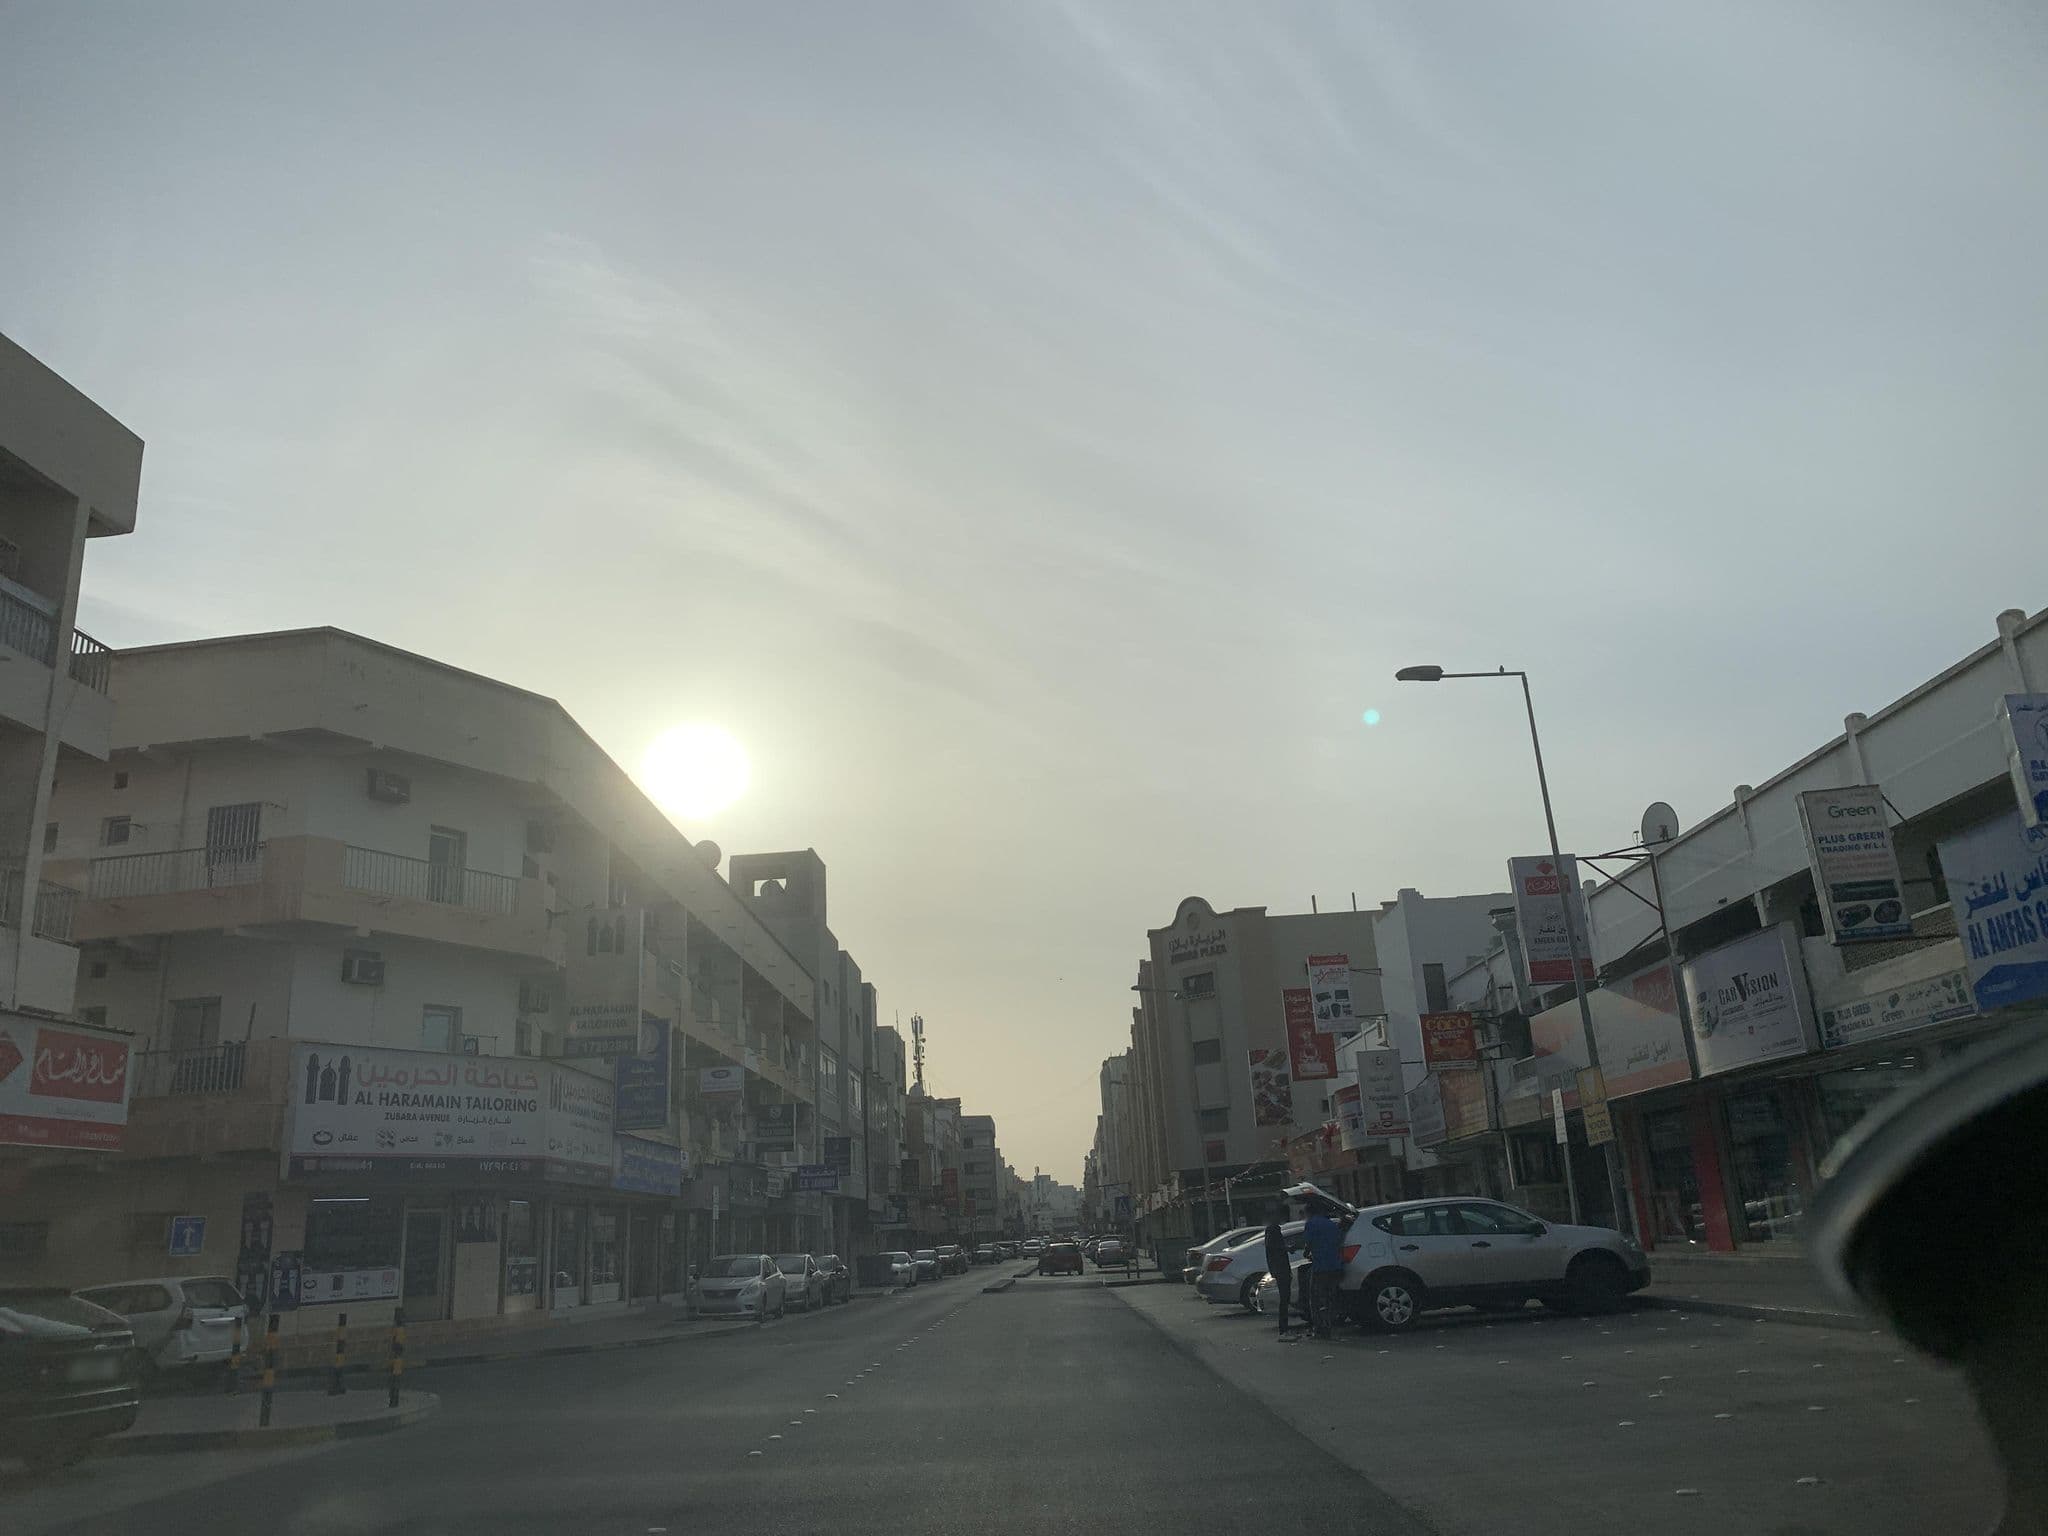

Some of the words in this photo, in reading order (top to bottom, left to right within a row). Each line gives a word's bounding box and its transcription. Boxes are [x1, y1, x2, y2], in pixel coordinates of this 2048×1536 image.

[1827, 805, 1877, 819] Green
[1817, 833, 1846, 845] PLUS
[1848, 830, 1885, 843] GREEN
[1820, 844, 1860, 854] TRADING
[1967, 921, 1990, 960] AL
[1986, 903, 2040, 956] ANFAS
[356, 1058, 458, 1091] الحرمين
[464, 1059, 538, 1096] خياطة
[354, 1090, 375, 1106] AL
[378, 1091, 461, 1110] HARAMAIN
[464, 1095, 538, 1113] TAILORING
[384, 1111, 418, 1122] ZUBARA
[418, 1112, 452, 1124] AVENUE
